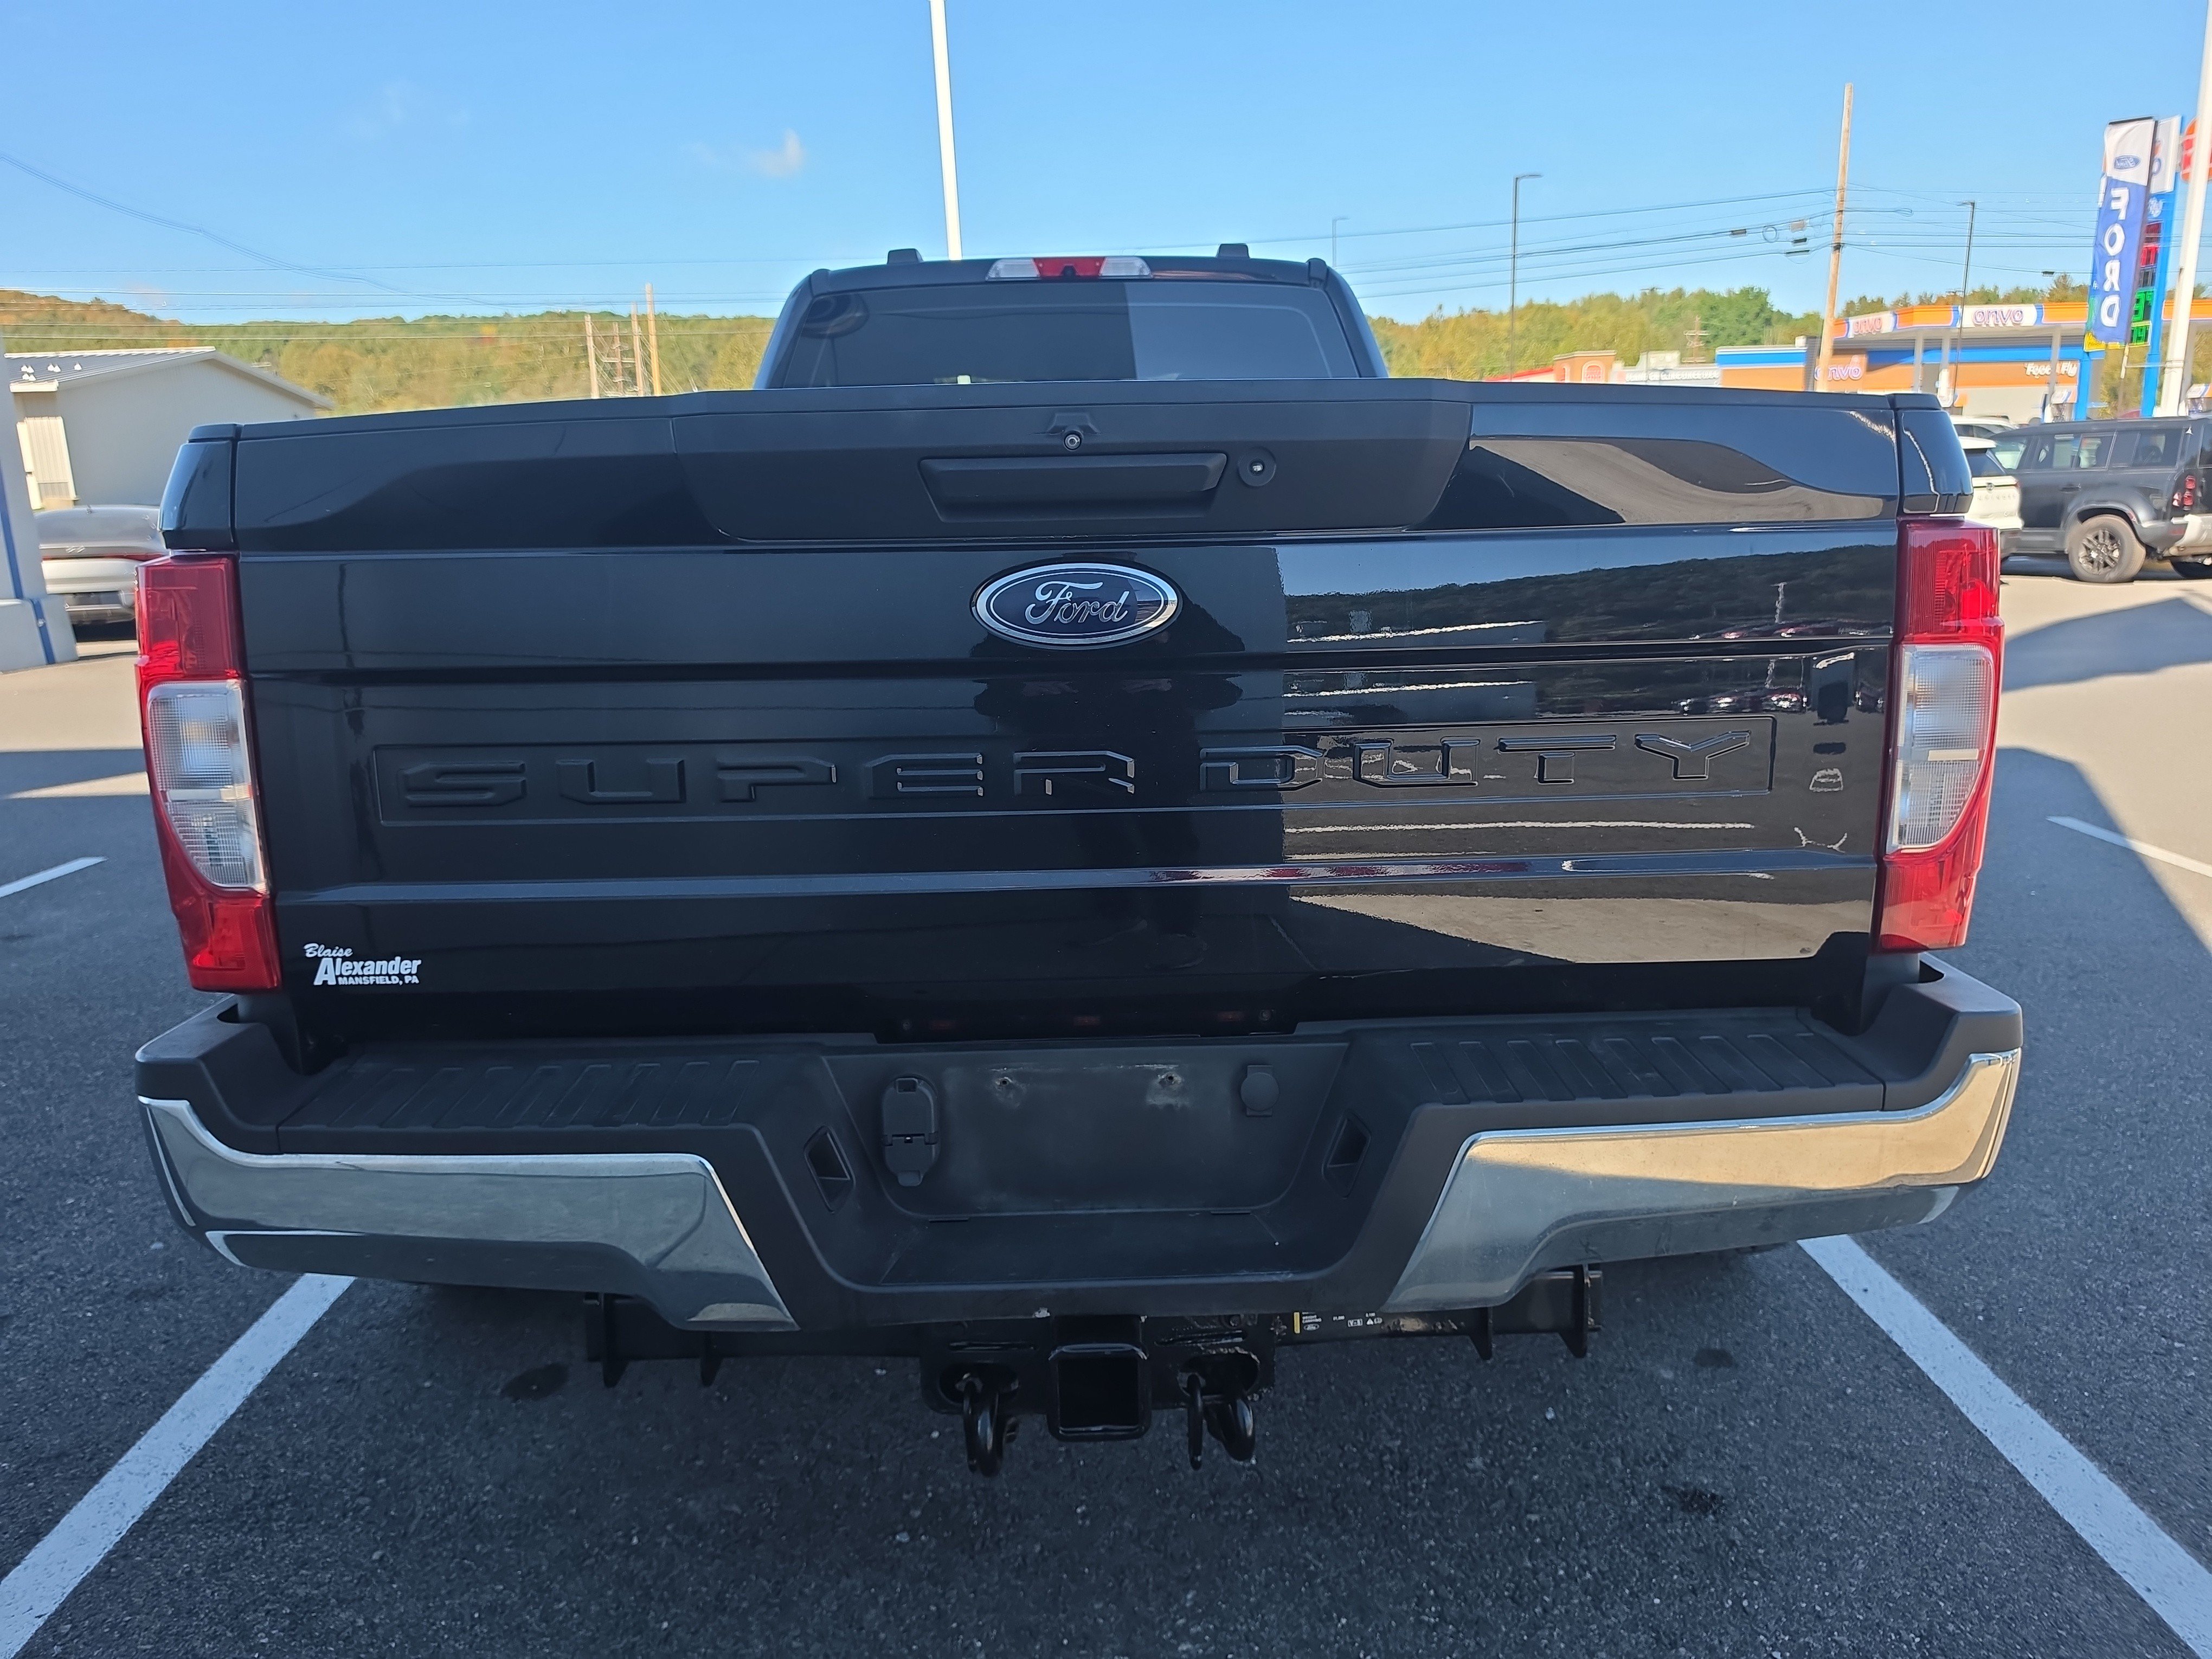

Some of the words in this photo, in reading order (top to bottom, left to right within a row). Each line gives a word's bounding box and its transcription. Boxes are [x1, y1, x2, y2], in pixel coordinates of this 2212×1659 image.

[1025, 581, 1130, 625] Ford
[399, 750, 1134, 807] SUPER
[1199, 730, 1752, 792] DUTY
[304, 943, 353, 957] Blaise
[313, 956, 422, 986] Alexander
[338, 976, 403, 986] MANSFIELD,
[404, 975, 420, 984] PA
